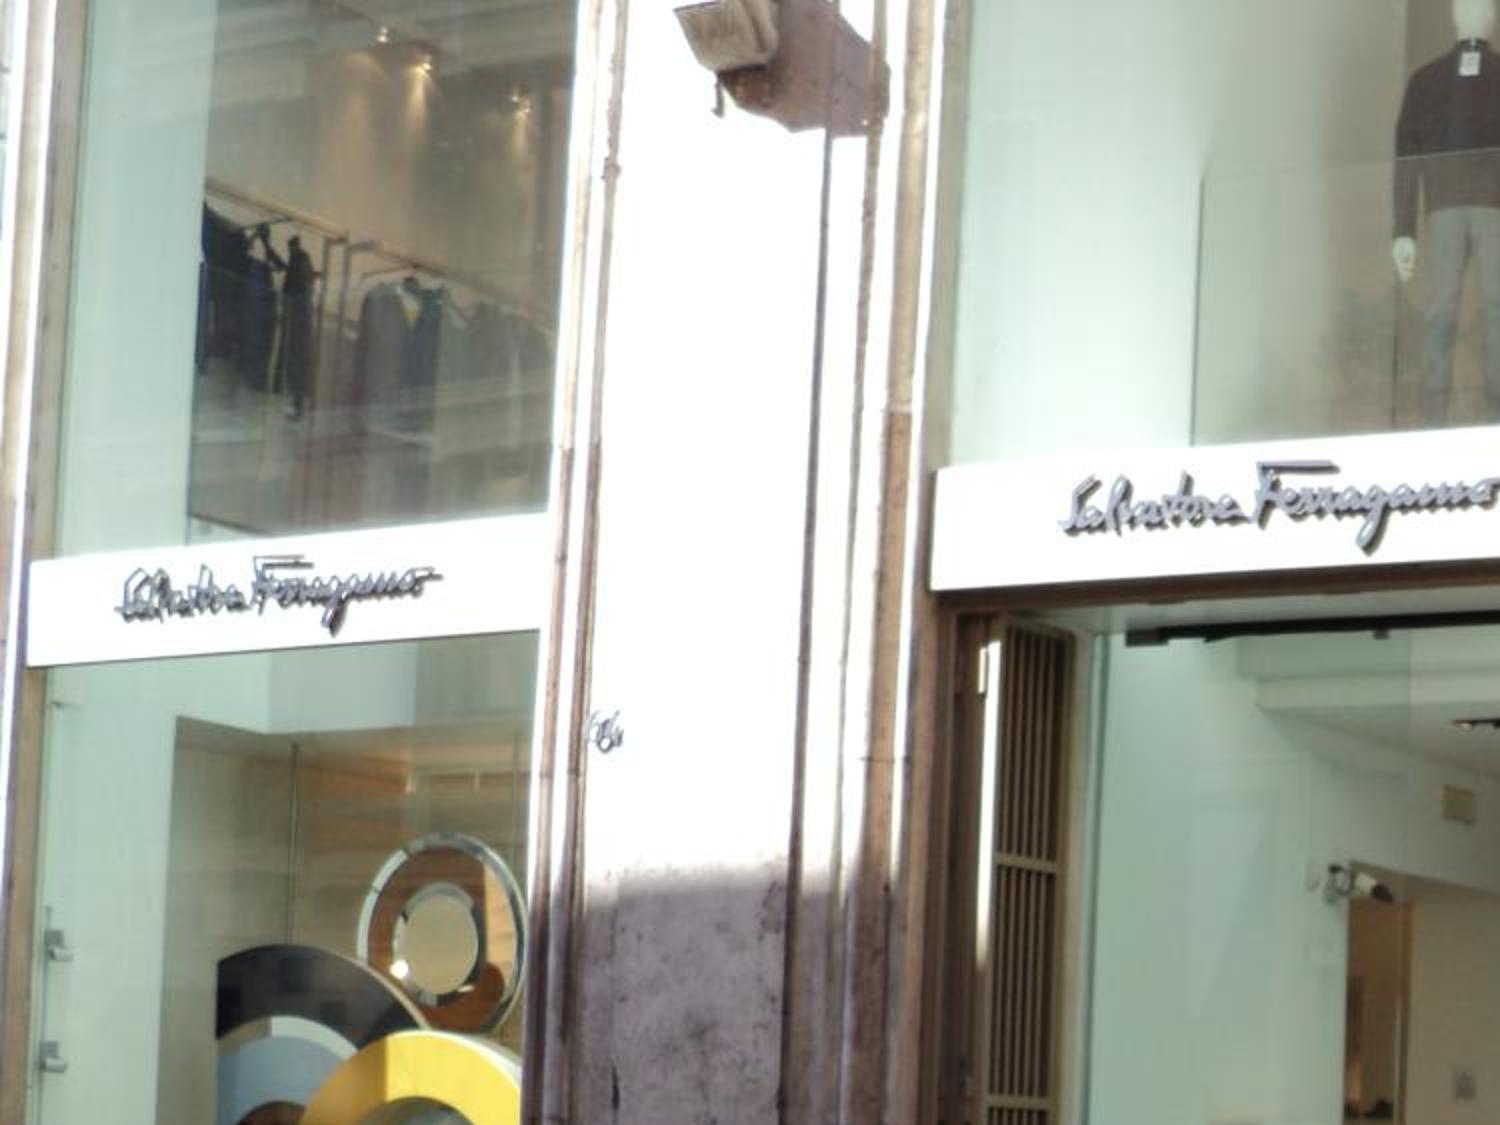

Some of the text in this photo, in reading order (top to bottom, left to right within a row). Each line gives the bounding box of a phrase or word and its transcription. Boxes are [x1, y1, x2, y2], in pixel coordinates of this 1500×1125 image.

[1061, 471, 1251, 536] Salvatore
[115, 556, 443, 637] Salvatore Ferragamo
